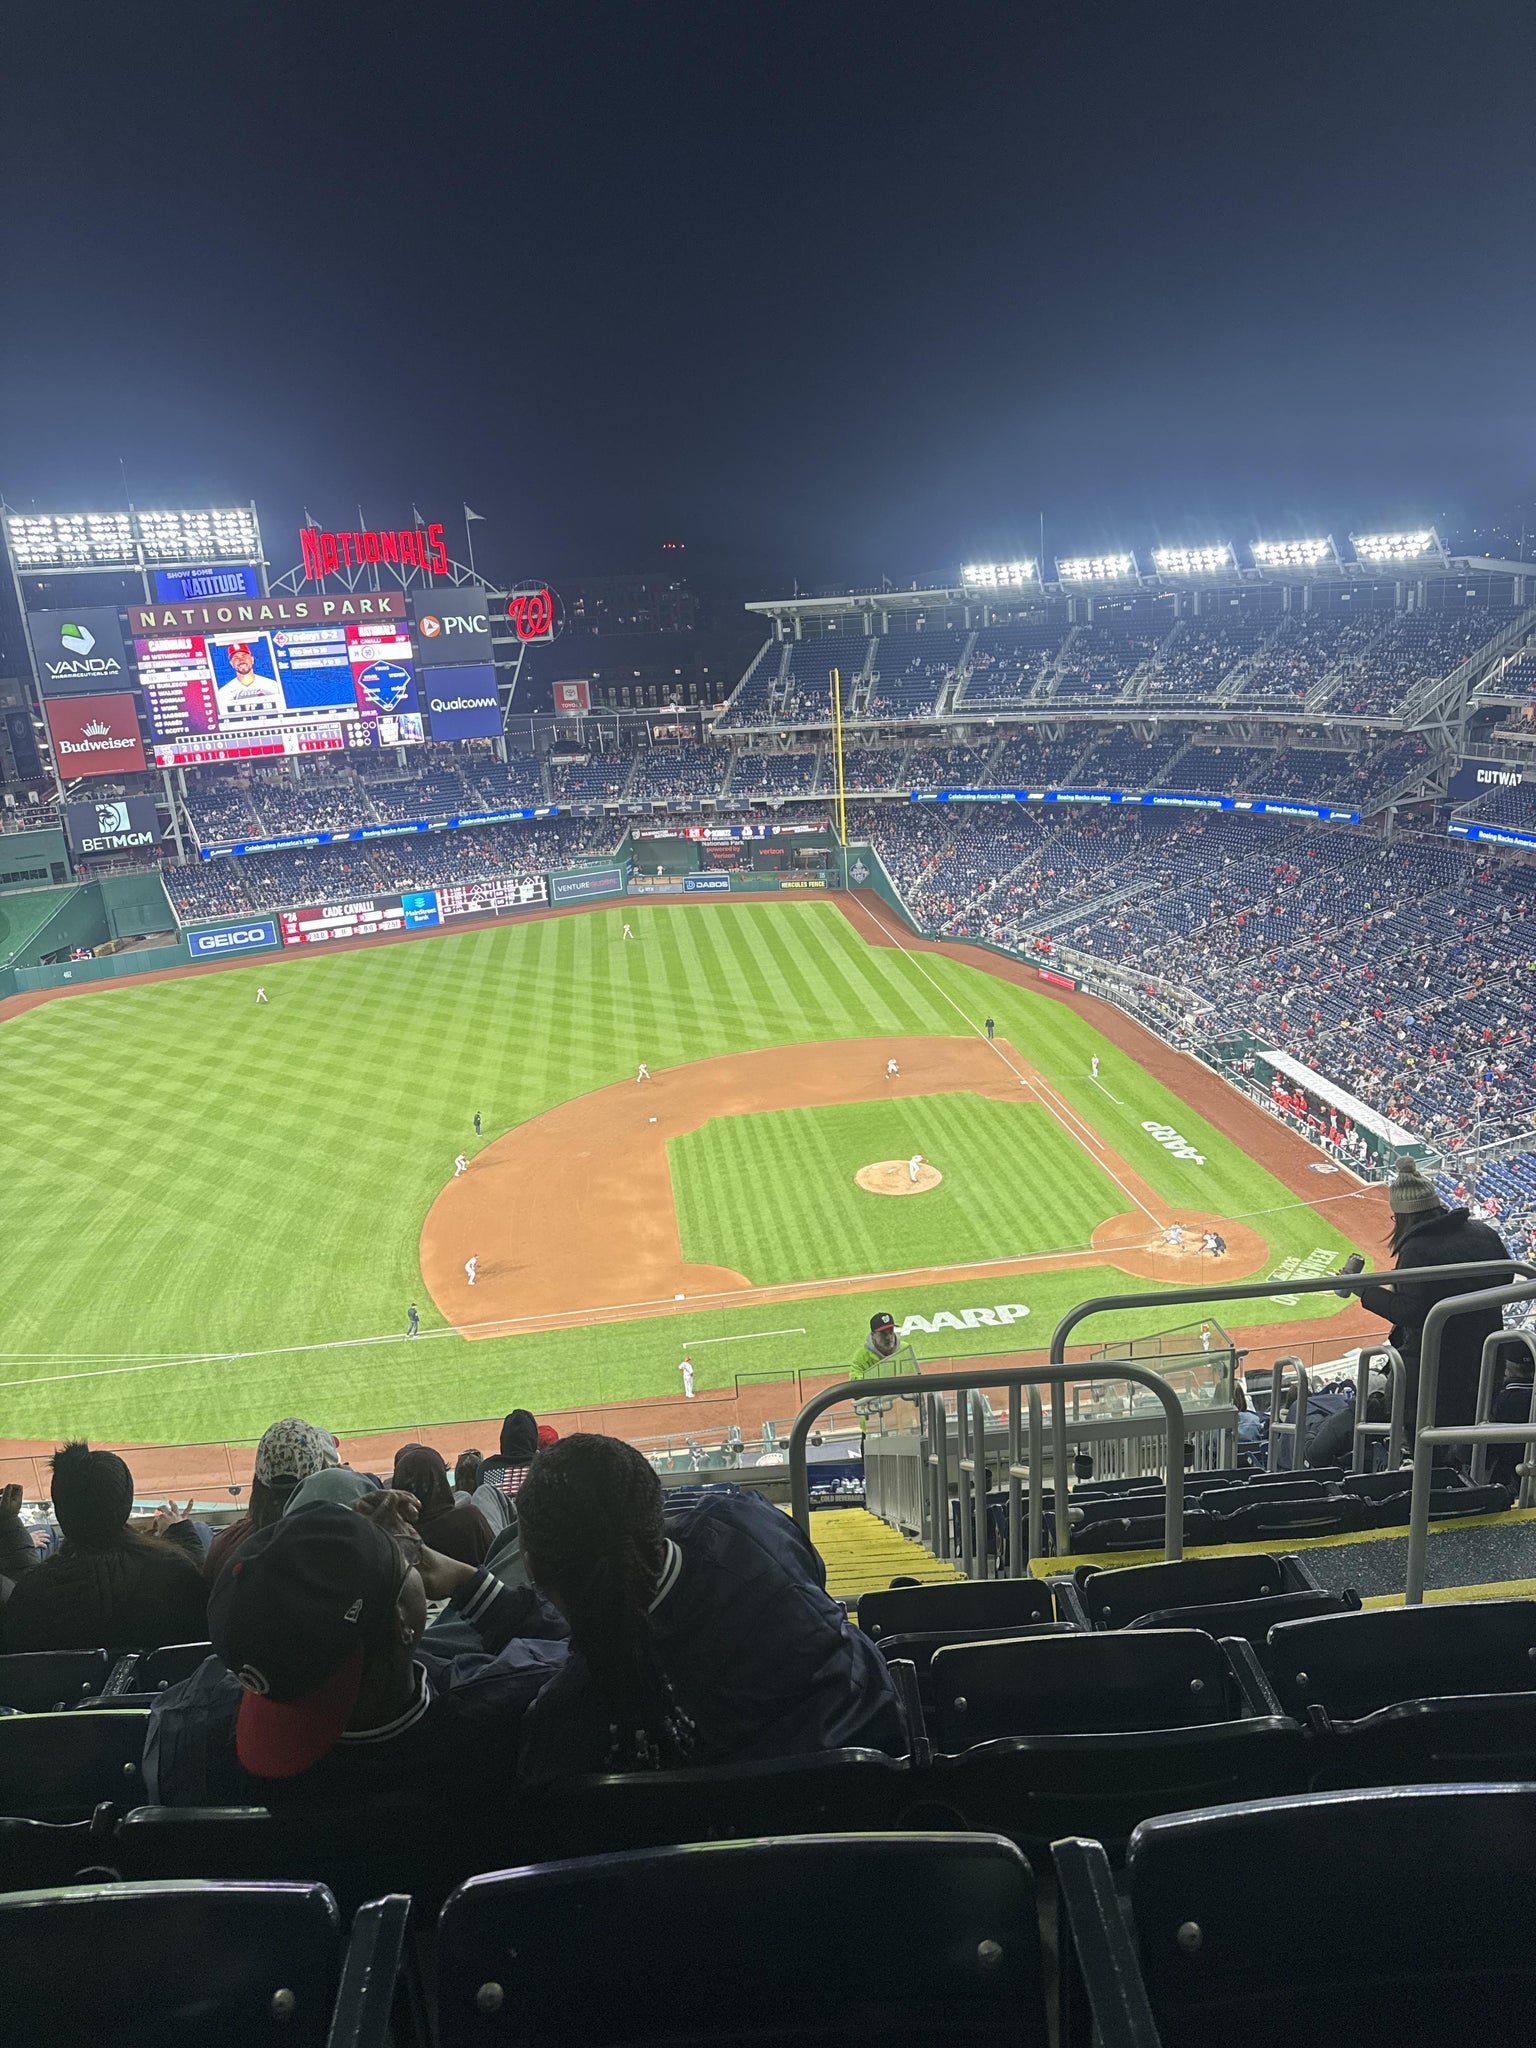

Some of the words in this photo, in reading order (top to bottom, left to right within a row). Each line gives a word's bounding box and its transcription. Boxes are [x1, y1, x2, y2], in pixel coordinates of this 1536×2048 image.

[299, 523, 448, 580] NATIONALS
[166, 570, 190, 580] SHOW
[192, 568, 213, 577] SOME
[181, 574, 246, 597] NATITUDE
[140, 603, 309, 627] NATIONALS
[322, 598, 392, 616] PARK
[442, 614, 488, 635] PNC
[44, 658, 121, 675] VANDA
[51, 672, 106, 680] PHARMACEUTICALS
[430, 696, 497, 712] Qualcomm
[58, 736, 136, 754] Budweiser
[1153, 797, 1182, 806] Celebrating
[1298, 808, 1319, 816] America
[397, 825, 418, 833] America
[458, 816, 486, 826] Celebrating
[82, 832, 153, 851] BETMGM
[1478, 830, 1497, 842] Boeing
[1497, 834, 1514, 843] Backs
[244, 842, 276, 852] Celebrating
[558, 882, 590, 892] VENTURE
[322, 904, 343, 918] CADE
[344, 901, 374, 914] CAVALLI
[405, 908, 436, 916] MainStreet
[198, 928, 265, 950] GEICO
[1141, 1121, 1208, 1166] AARP
[1299, 1247, 1339, 1272] WEEK
[894, 1304, 1031, 1336] AARP
